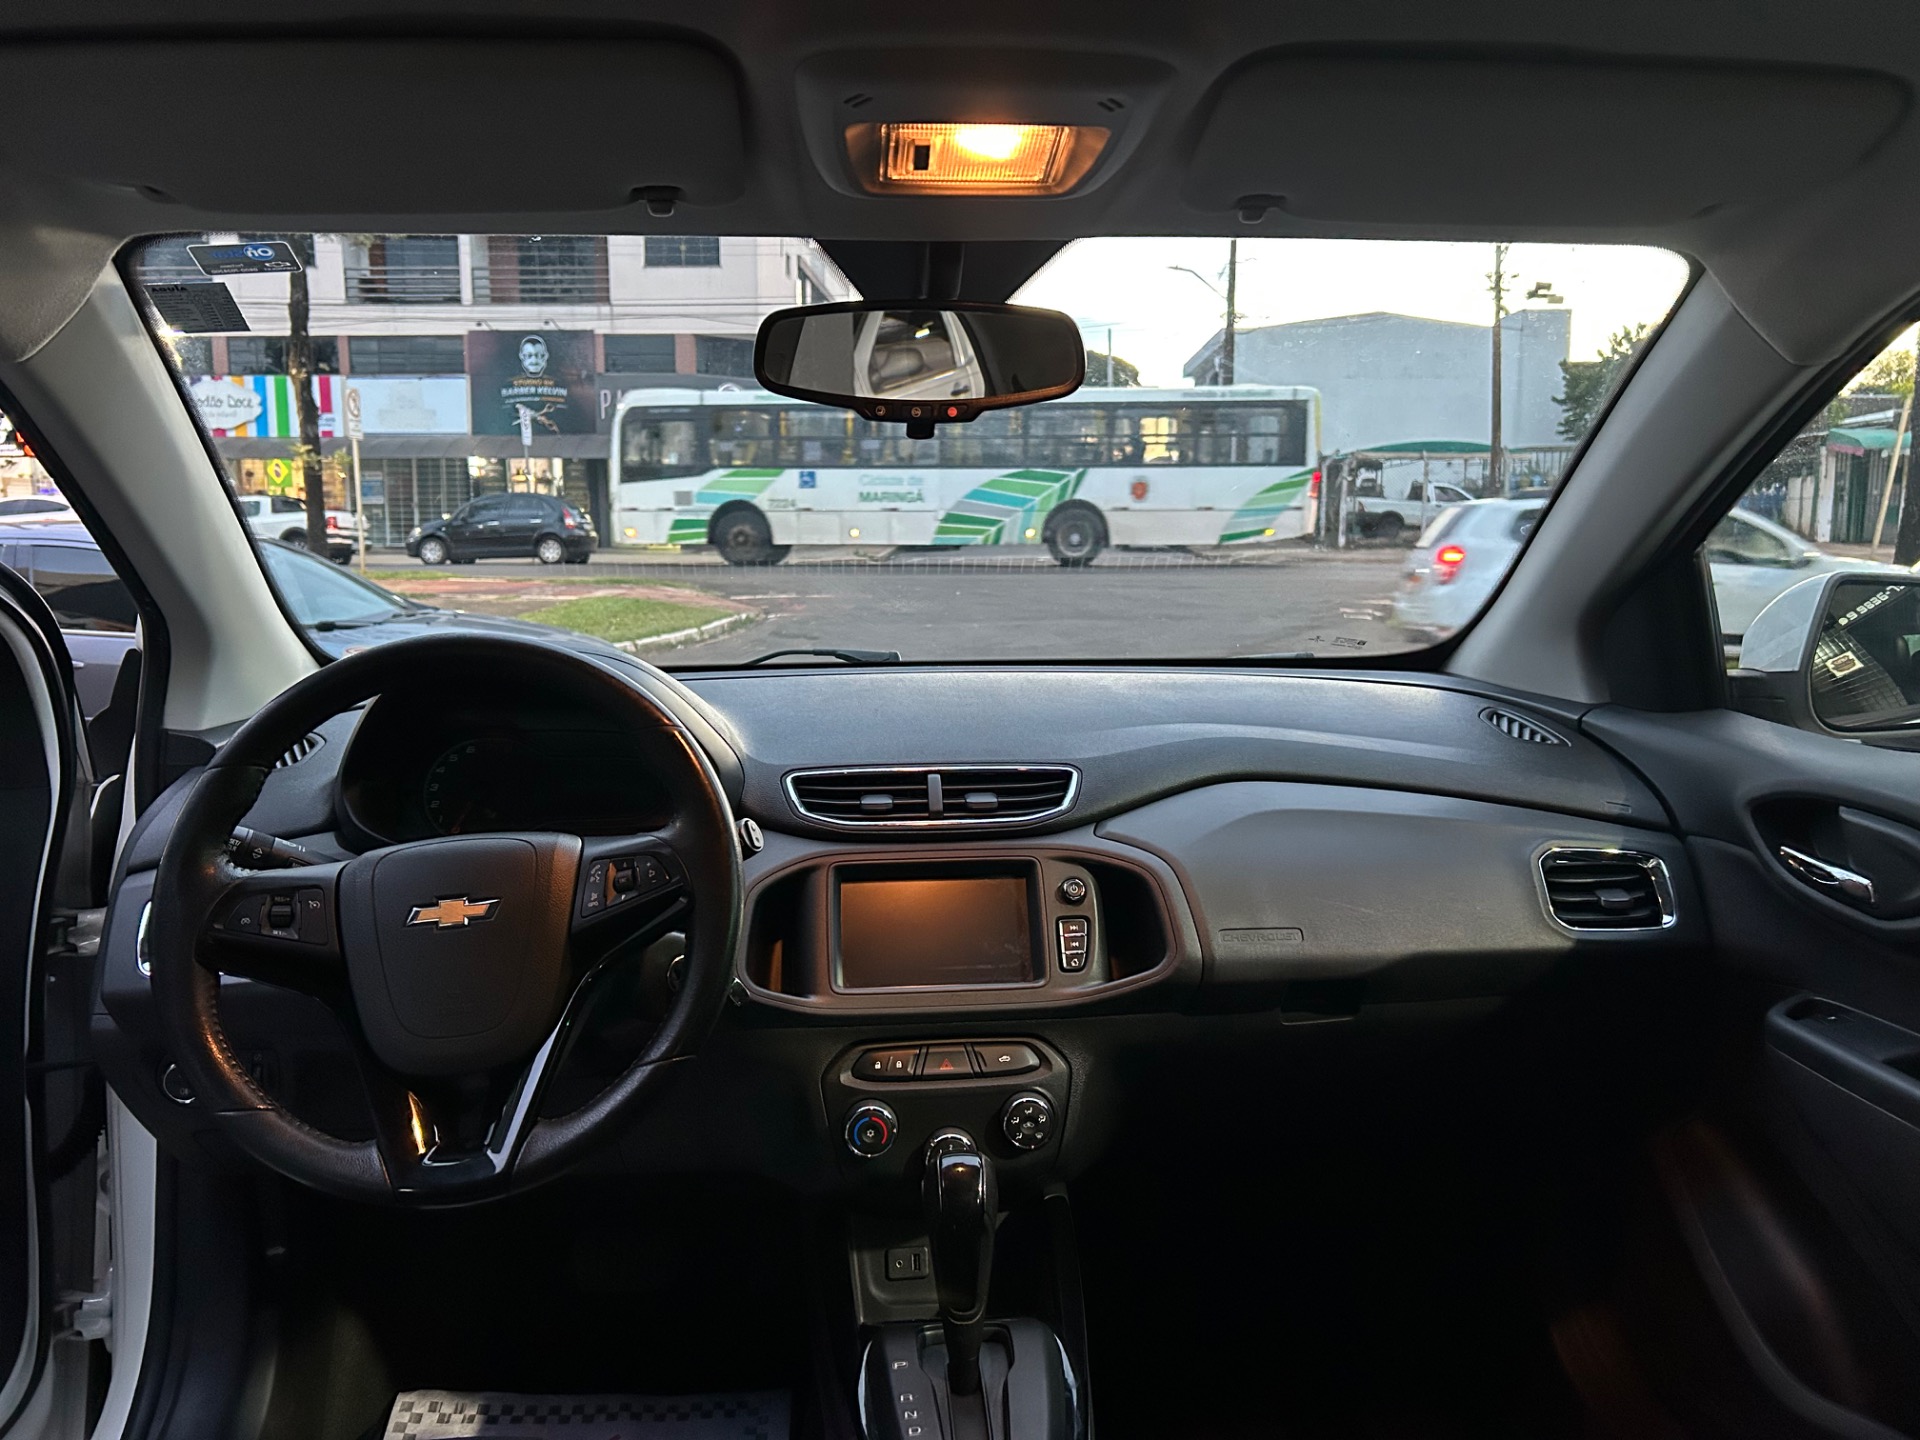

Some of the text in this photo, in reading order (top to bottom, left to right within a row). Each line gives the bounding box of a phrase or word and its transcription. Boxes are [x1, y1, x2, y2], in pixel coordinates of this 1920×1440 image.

[501, 386, 567, 397] BARBER KELVIN
[859, 489, 925, 503] MARINGÁ
[1222, 932, 1300, 942] CHEVROLET
[891, 1361, 908, 1370] P
[904, 1410, 918, 1420] N
[908, 1426, 922, 1437] D
